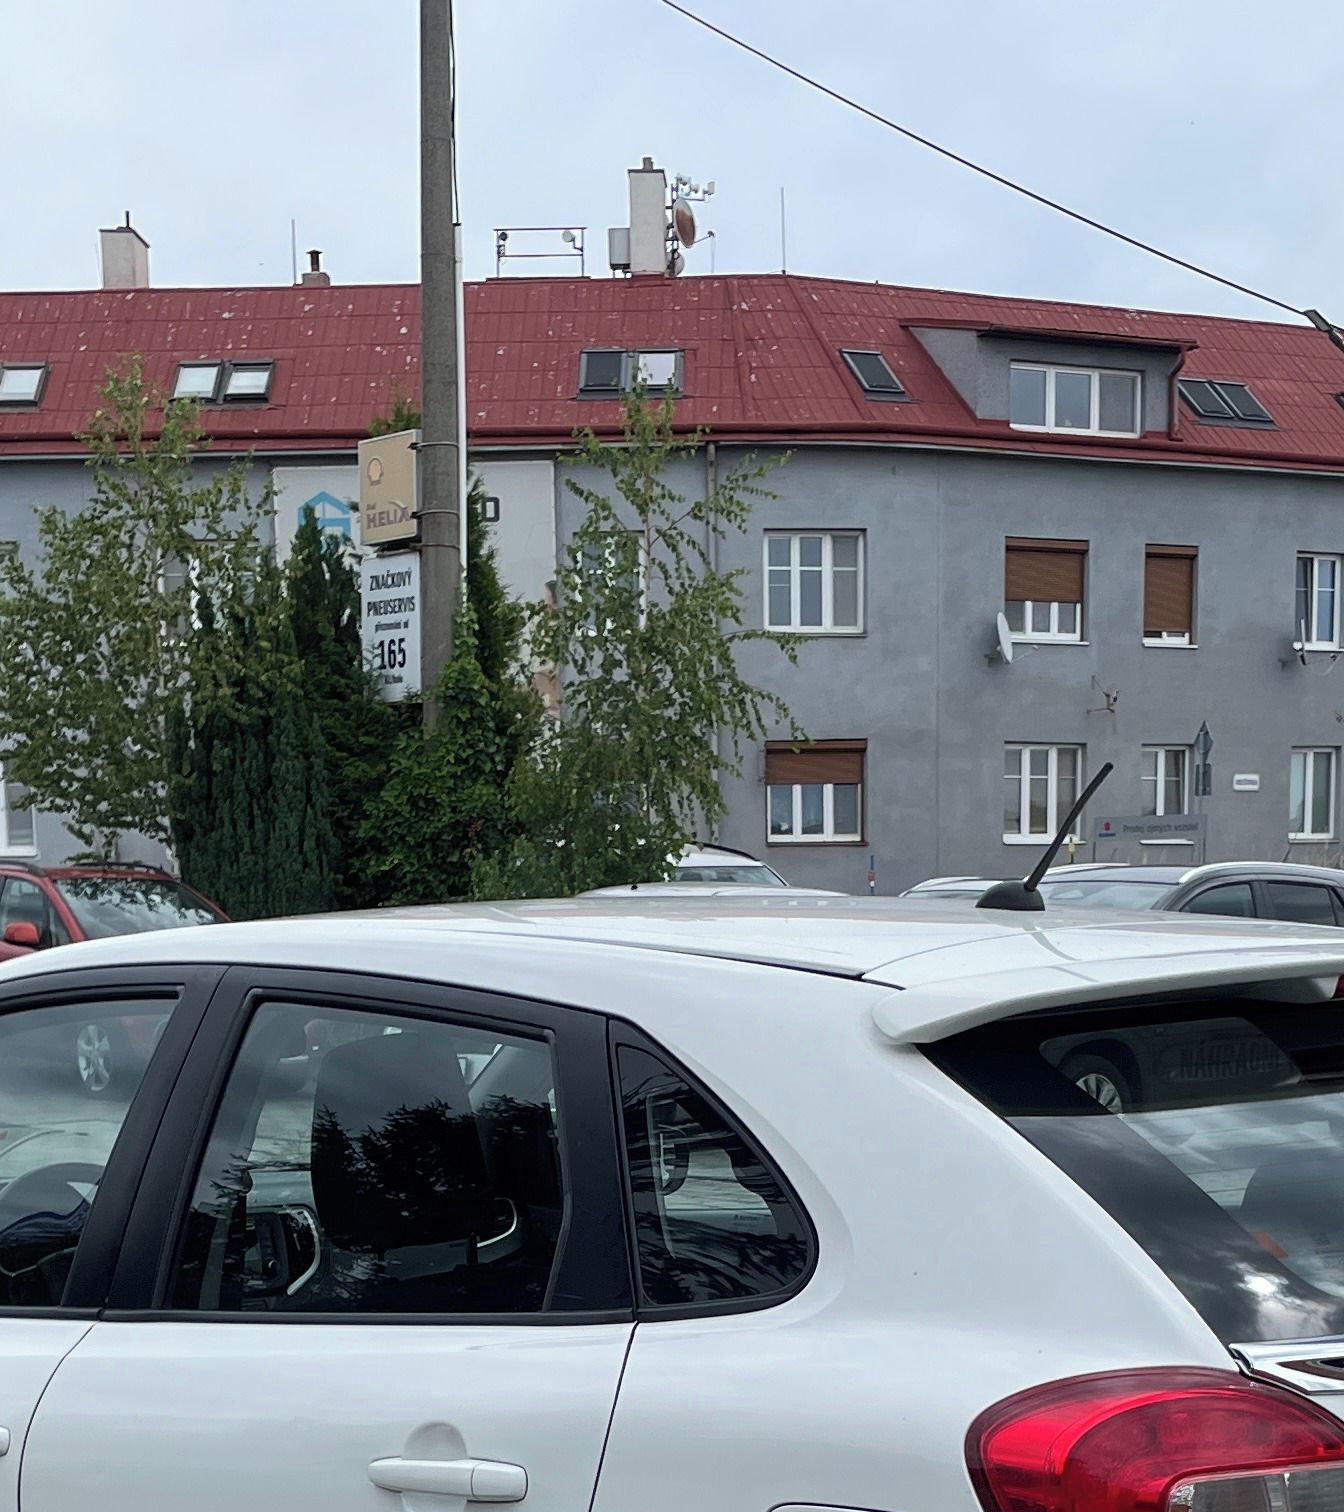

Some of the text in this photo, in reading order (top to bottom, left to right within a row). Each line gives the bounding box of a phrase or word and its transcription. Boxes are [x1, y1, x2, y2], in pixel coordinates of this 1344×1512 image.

[367, 506, 411, 529] HELIX
[370, 567, 412, 591] ZNAČKOVÝ
[367, 596, 415, 617] PNEUSERVIS
[378, 638, 406, 670] 165
